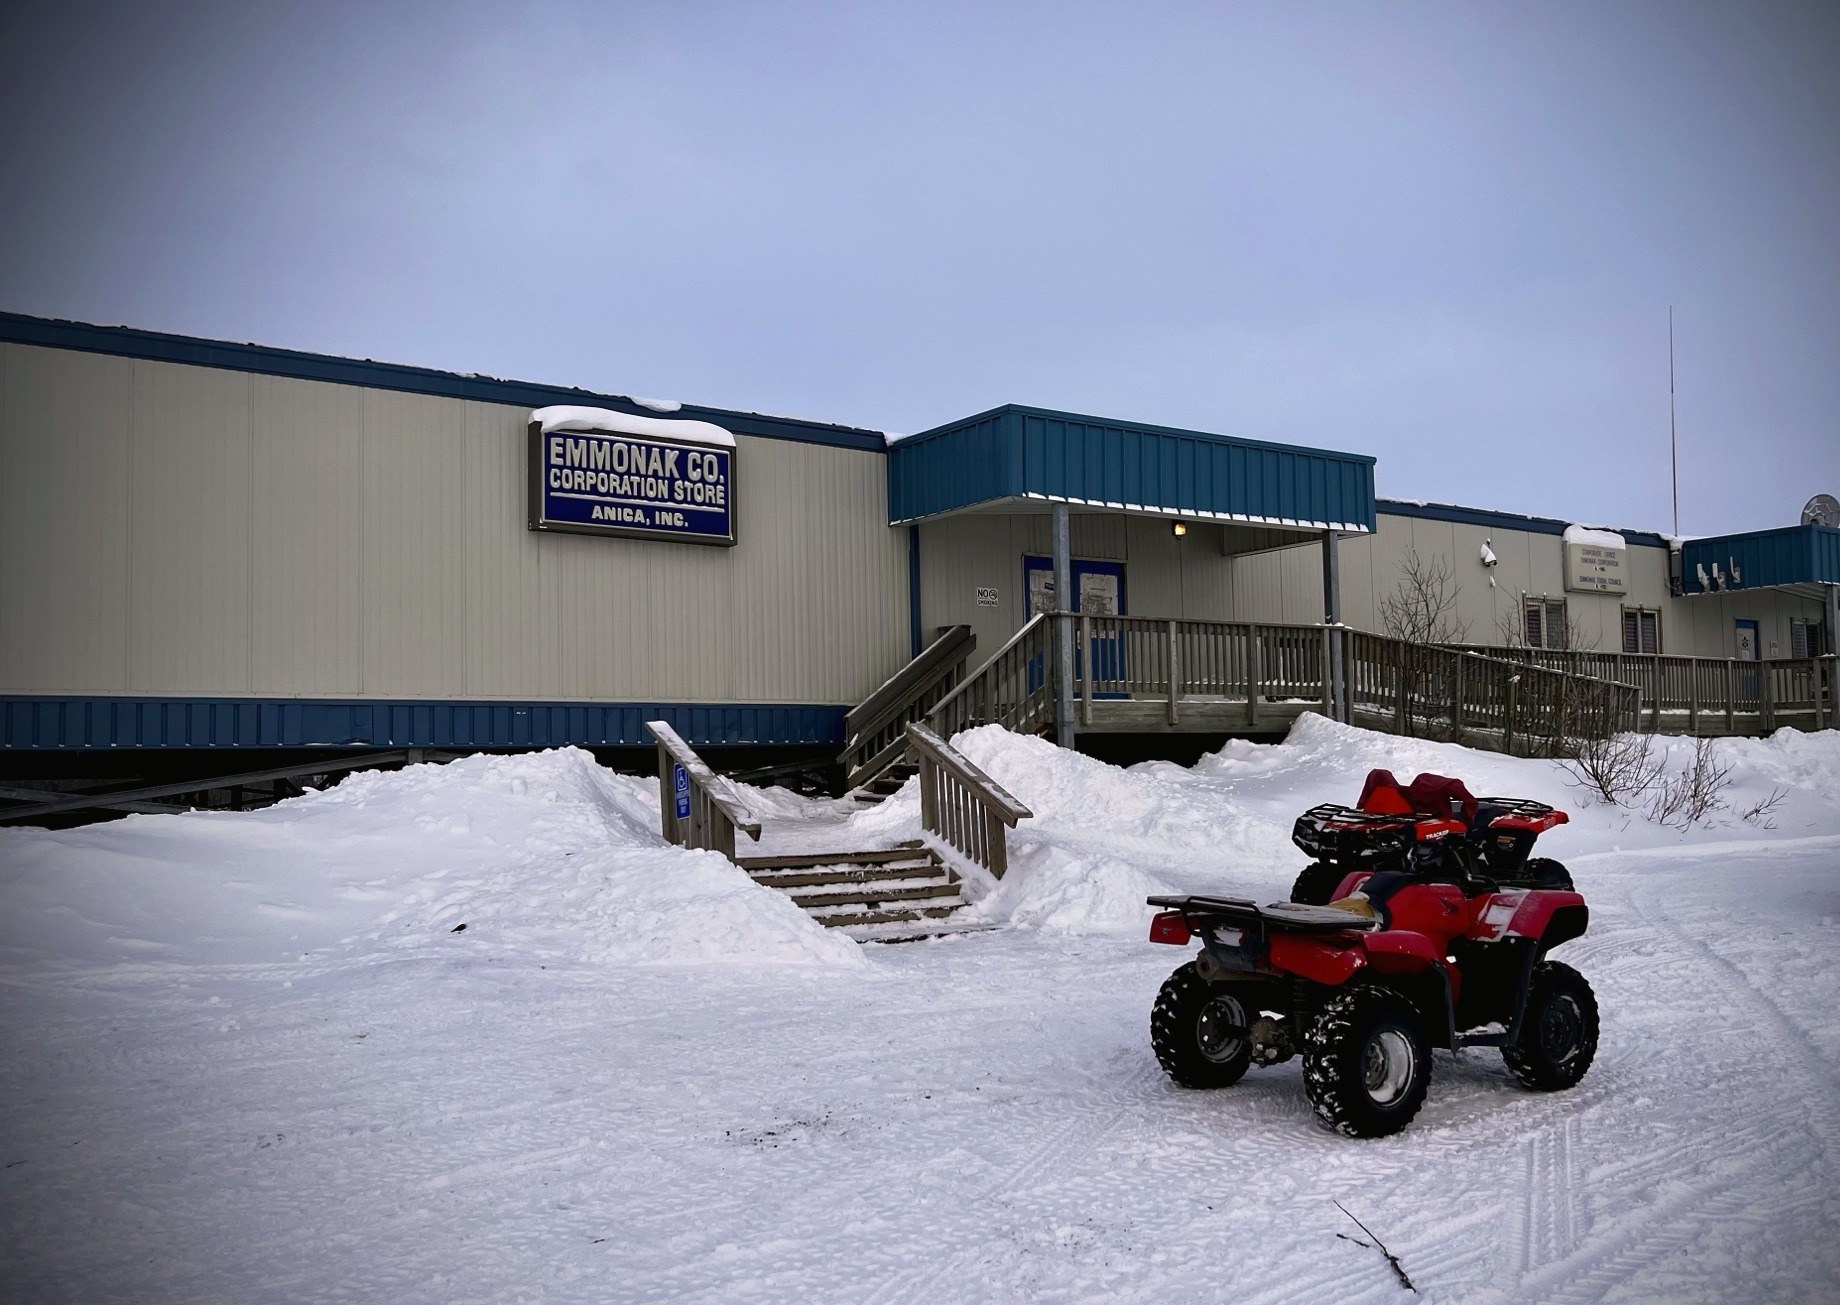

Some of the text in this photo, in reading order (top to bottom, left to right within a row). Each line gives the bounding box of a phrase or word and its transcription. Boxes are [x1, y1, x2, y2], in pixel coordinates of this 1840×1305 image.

[550, 437, 725, 483] EMMONAK CO.
[550, 468, 725, 505] CORPORATION STORE
[591, 505, 689, 527] ANICA, INC.
[977, 588, 989, 598] NO
